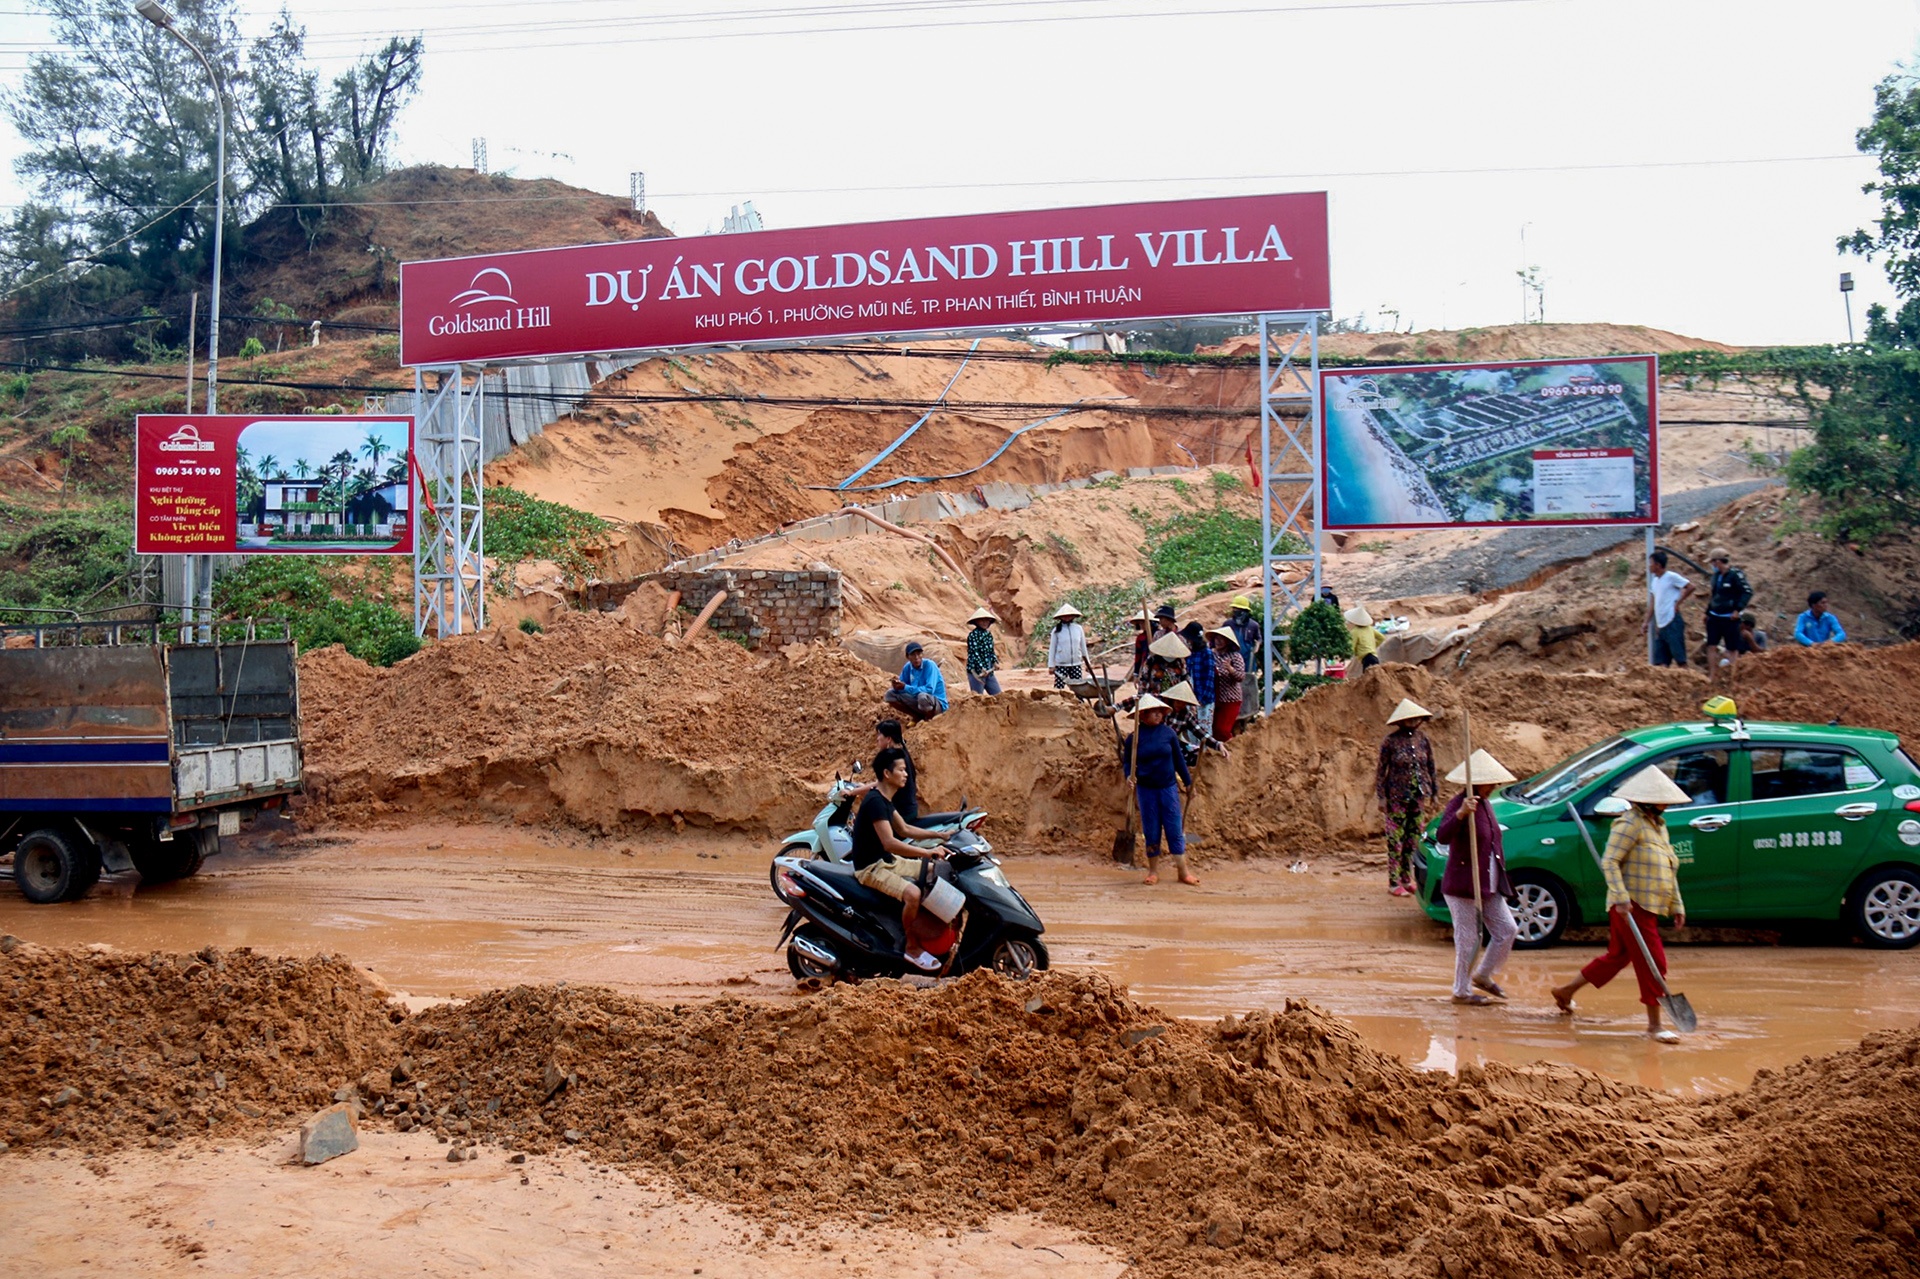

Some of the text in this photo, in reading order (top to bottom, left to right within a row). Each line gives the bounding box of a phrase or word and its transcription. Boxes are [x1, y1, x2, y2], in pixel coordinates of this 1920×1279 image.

[585, 224, 1293, 311] DỰ ÁN GOLDSAND HILL VILLA
[695, 285, 1142, 329] KHU PHỐ 1, PHƯỜNG MŨI NÉ, TP. PHAN THIẾT, BÌNH THUẬN
[429, 306, 551, 337] Goldsand Hill
[1541, 384, 1622, 397] 0969 34 90 90
[198, 441, 215, 451] Hill
[155, 467, 221, 476] 0969 34 90 90
[172, 522, 196, 531] View
[206, 532, 225, 543] hạn
